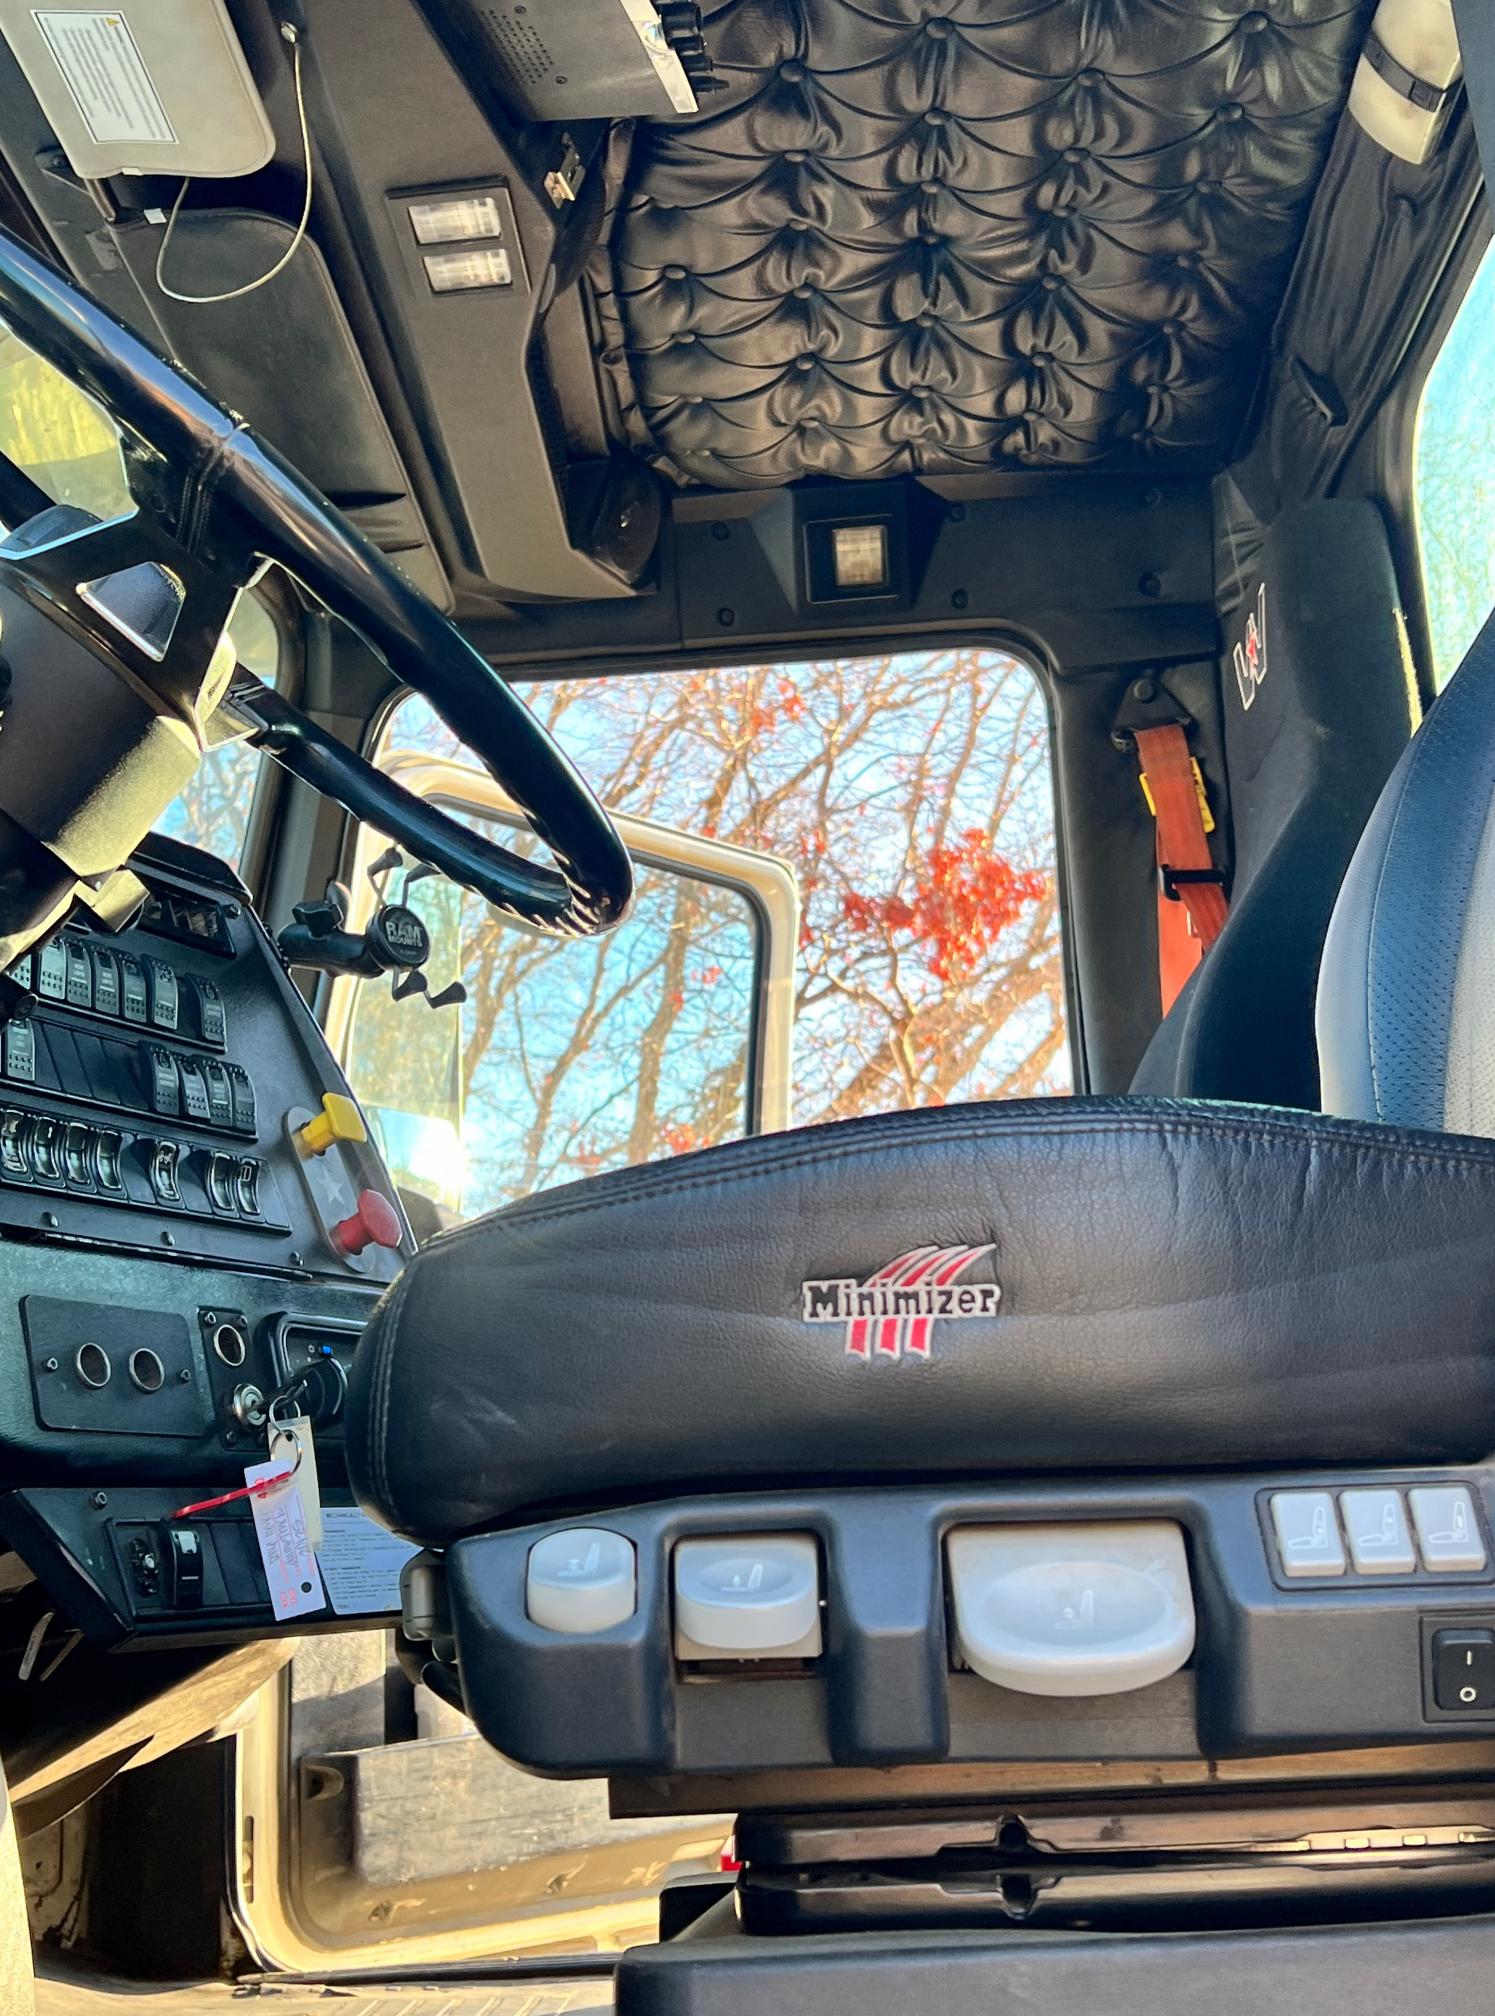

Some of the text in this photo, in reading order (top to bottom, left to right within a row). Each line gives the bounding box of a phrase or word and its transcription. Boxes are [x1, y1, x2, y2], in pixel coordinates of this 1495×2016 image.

[385, 921, 422, 940] RAM
[388, 935, 423, 947] MOUNTS
[806, 1281, 996, 1319] Minimizer
